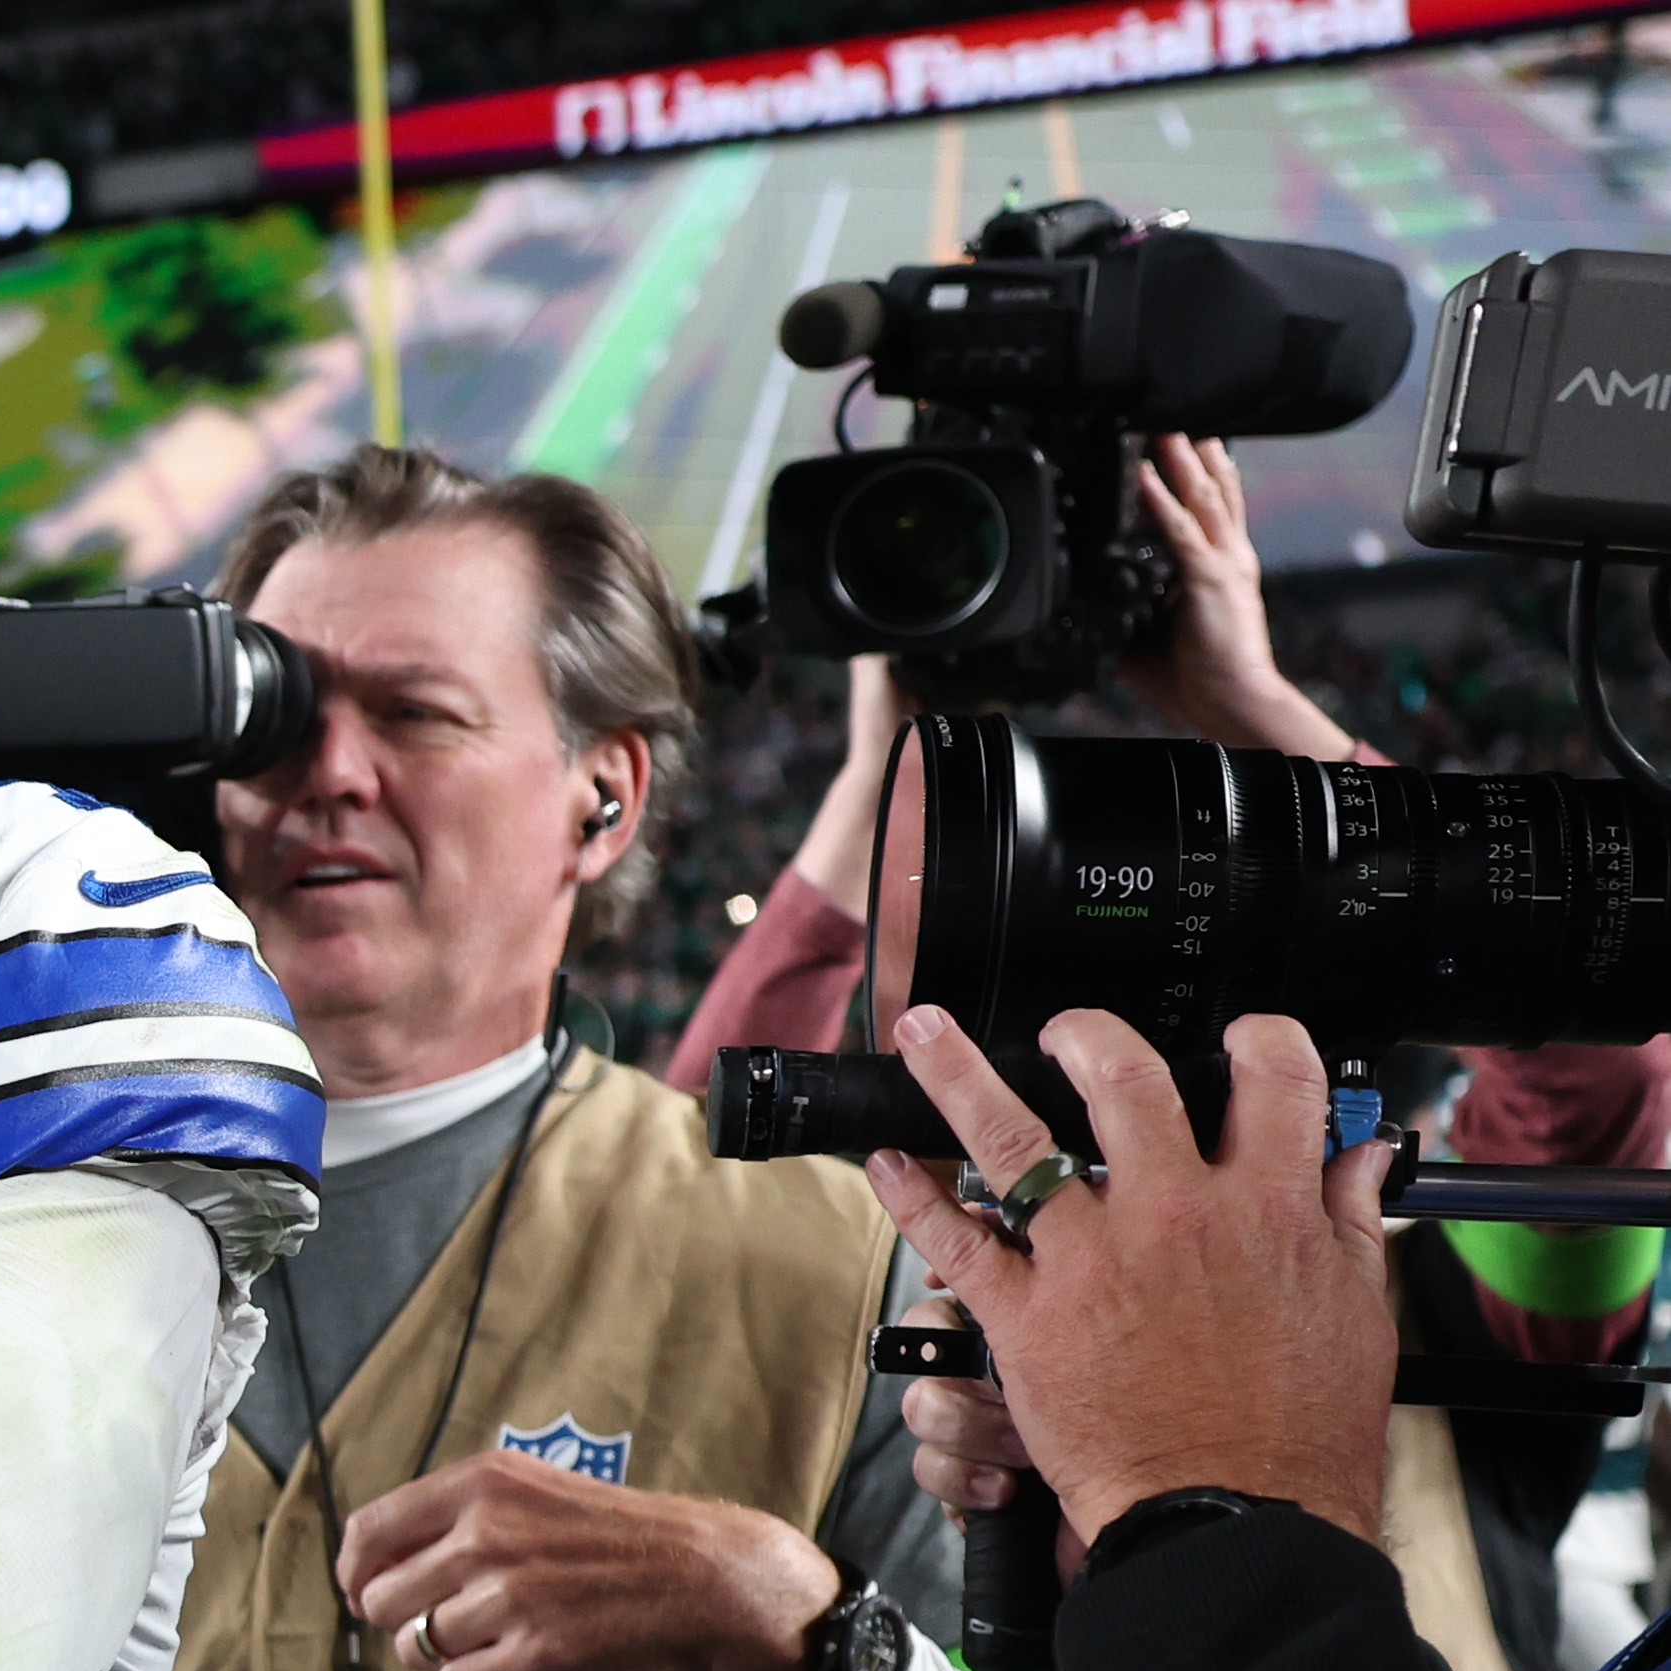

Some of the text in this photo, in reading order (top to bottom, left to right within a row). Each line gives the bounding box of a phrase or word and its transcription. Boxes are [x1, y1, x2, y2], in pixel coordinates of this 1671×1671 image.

[628, 0, 1413, 150] Lincoln Financial Field
[1486, 814, 1514, 828] 30
[1488, 843, 1515, 860] 25
[1357, 863, 1369, 880] 3
[1488, 867, 1515, 883] 22
[1075, 865, 1154, 899] 19-90
[1492, 888, 1514, 905] 19
[1075, 904, 1149, 918] FUJINON
